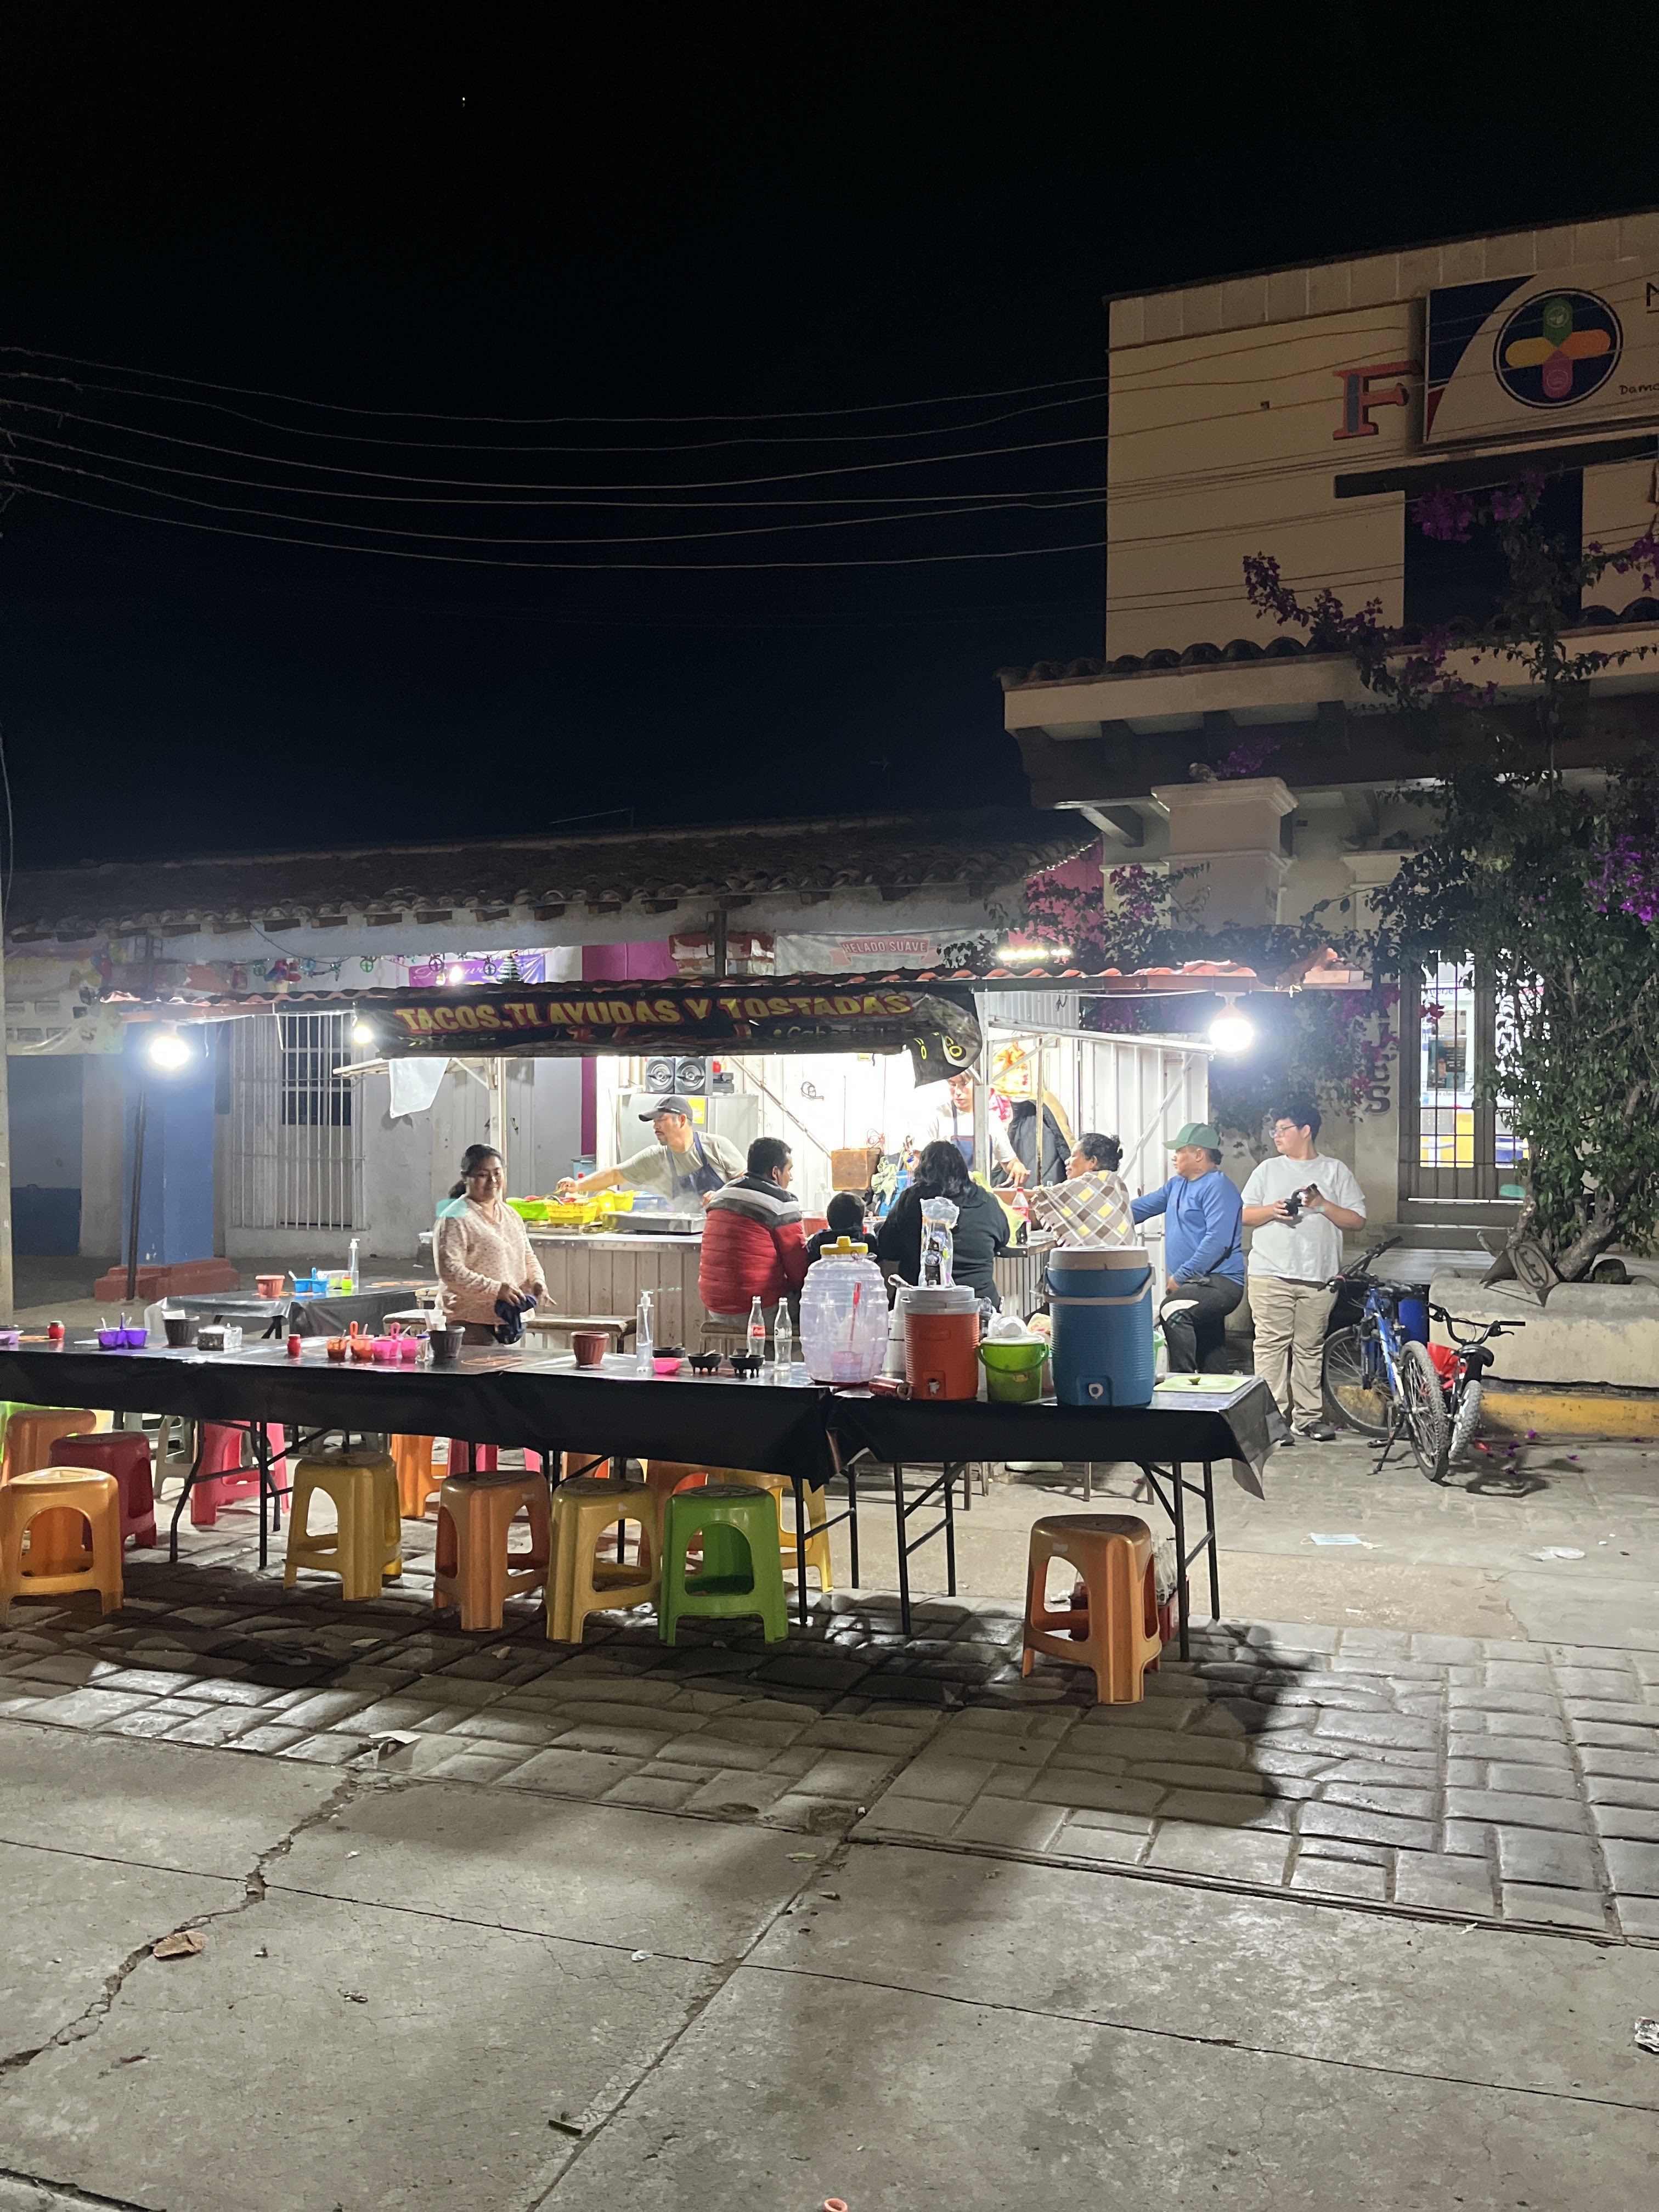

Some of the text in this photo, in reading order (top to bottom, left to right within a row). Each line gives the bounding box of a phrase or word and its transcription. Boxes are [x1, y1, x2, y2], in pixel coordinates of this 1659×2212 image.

[842, 940, 927, 953] HELADO SUAVE
[685, 998, 709, 1020] Y
[719, 994, 911, 1019] TOSTADAS
